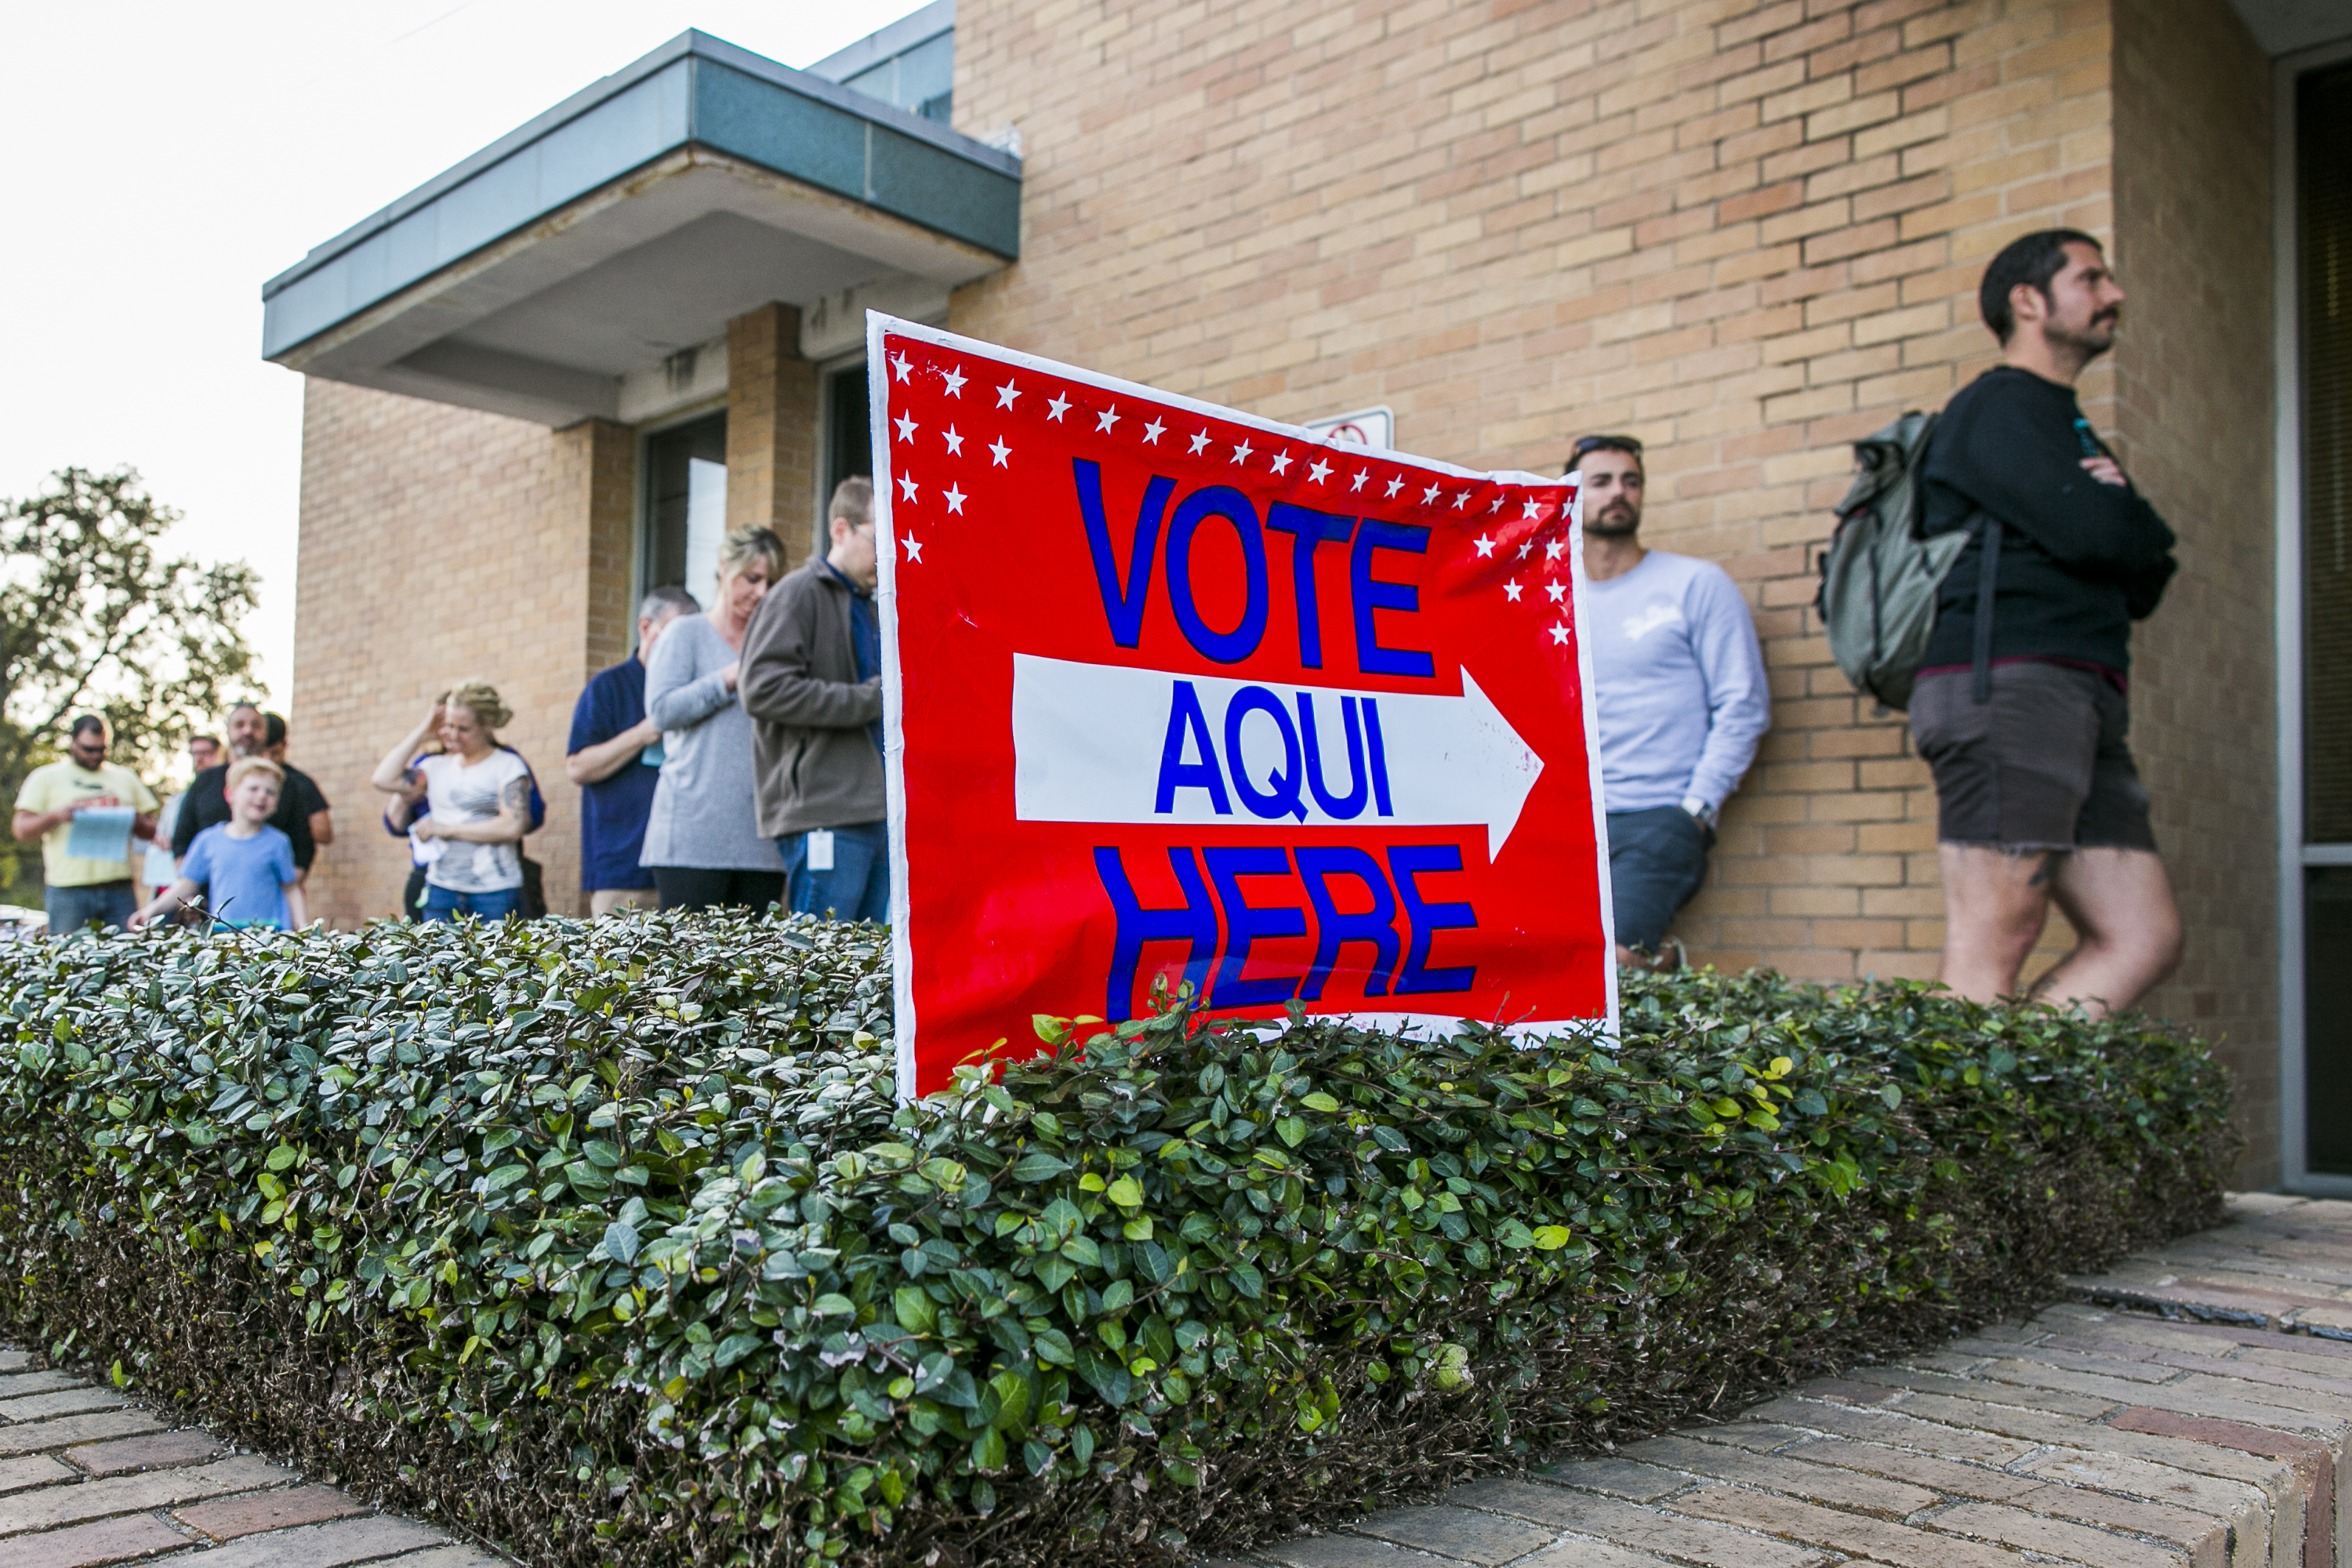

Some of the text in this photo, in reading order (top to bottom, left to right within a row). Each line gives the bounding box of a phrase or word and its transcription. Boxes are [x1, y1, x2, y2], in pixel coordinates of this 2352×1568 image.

[1073, 456, 1436, 678] VOTE
[1154, 680, 1394, 824] AQUI
[1092, 844, 1479, 1025] HERE
